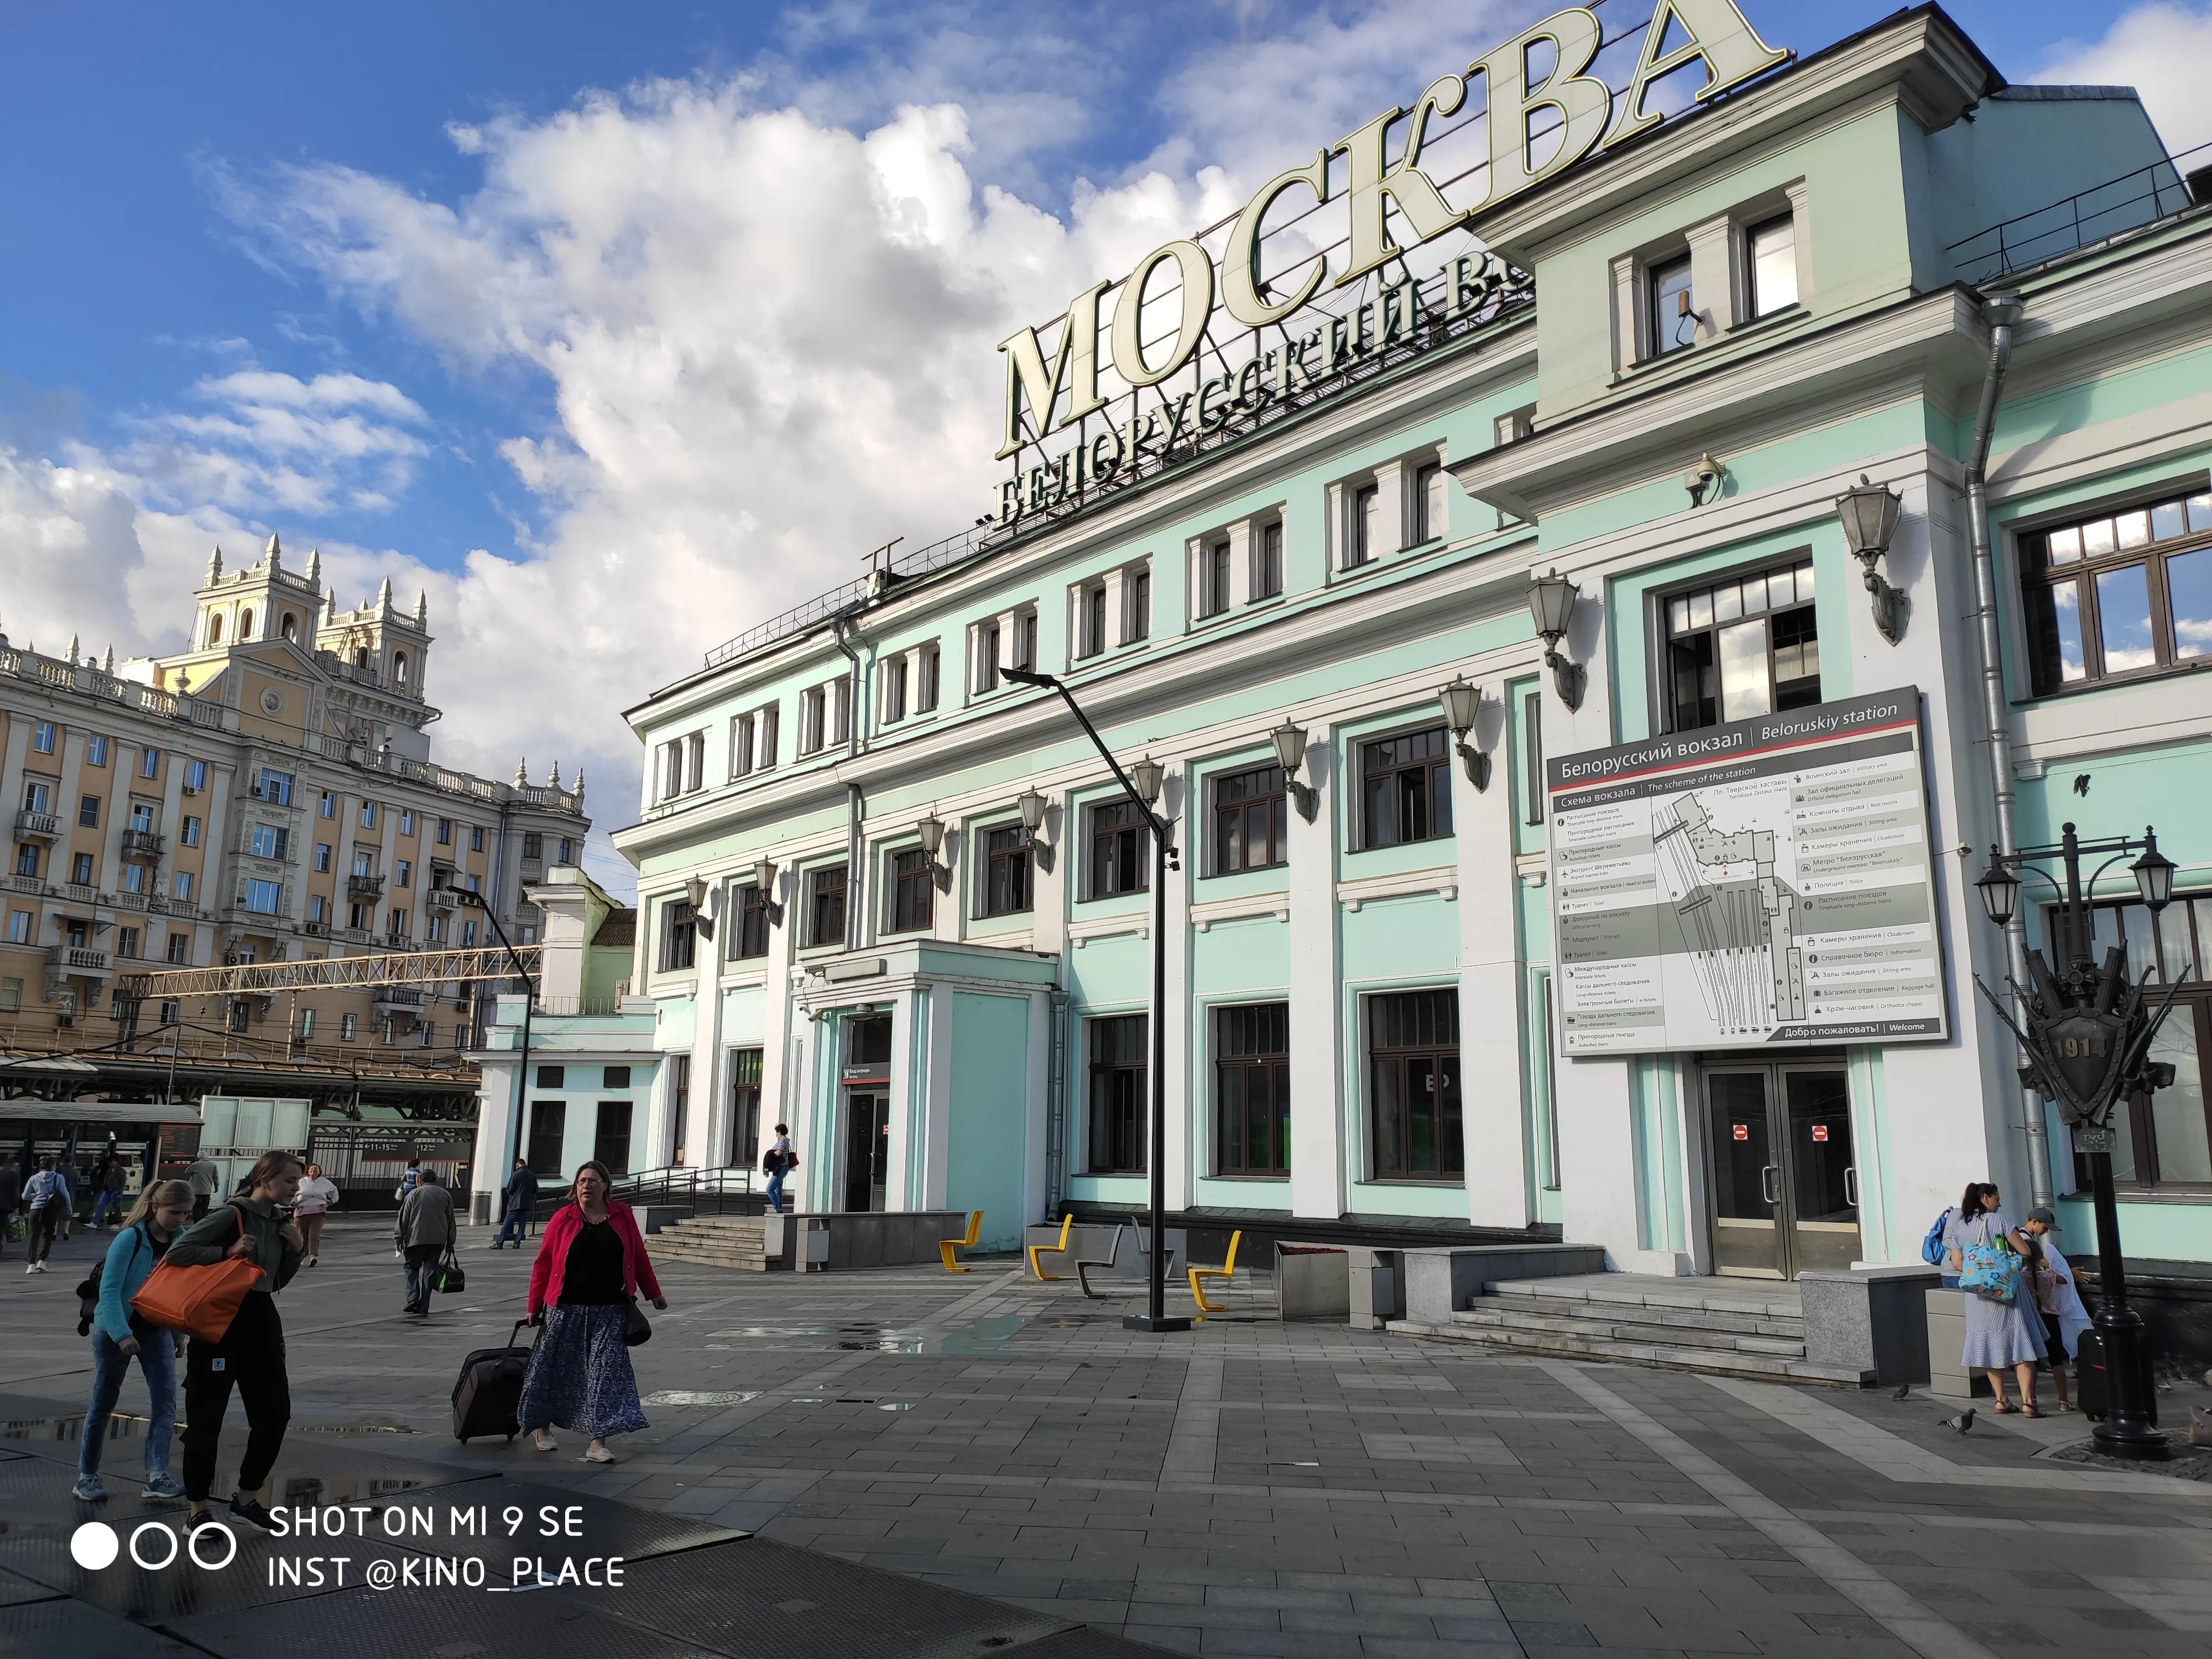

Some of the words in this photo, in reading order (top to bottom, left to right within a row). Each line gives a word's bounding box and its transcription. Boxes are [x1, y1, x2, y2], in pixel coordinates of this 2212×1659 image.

[995, 0, 1792, 461] МОСКВА
[994, 272, 1426, 529] БЕЛОРУССКИЙ
[1761, 714, 1839, 740] Beloruskiy
[1843, 704, 1898, 725] station
[1562, 742, 1672, 779] Белорусский
[1678, 732, 1743, 757] вокзал
[1648, 782, 1663, 792] The
[1665, 778, 1697, 790] scheme
[1698, 774, 1709, 784] of
[1709, 772, 1724, 781] the
[1725, 766, 1756, 779] station
[1759, 779, 1787, 788] заставы
[1820, 780, 1866, 794] официальных
[1867, 773, 1903, 786] делегаций
[1561, 795, 1592, 807] Схема
[1595, 787, 1636, 801] вокзала
[1825, 791, 1851, 800] delegation
[1841, 804, 1865, 813] отдыха
[1810, 825, 1827, 833] Залы
[1829, 821, 1863, 831] ожидания
[1812, 842, 1838, 851] Камеры
[1840, 837, 1872, 847] хранения
[1813, 858, 1835, 867] Метро
[1813, 865, 1846, 873] Underground
[1571, 886, 1599, 894] Начальник
[1814, 880, 1844, 889] Полиция
[1818, 894, 1857, 904] Расписание
[1859, 891, 1887, 899] поездов
[1572, 914, 1600, 923] Дежурный
[1820, 936, 1847, 944] Камеры
[1849, 933, 1881, 941] хранения
[1821, 953, 1863, 962] Справочное
[1864, 951, 1884, 959] бюро
[1858, 985, 1895, 994] отделение
[1785, 1027, 1816, 1039] Добро
[1819, 1023, 1879, 1036] пожаловать!
[1889, 1023, 1925, 1032] Welcome
[2054, 1037, 2107, 1058] 1914
